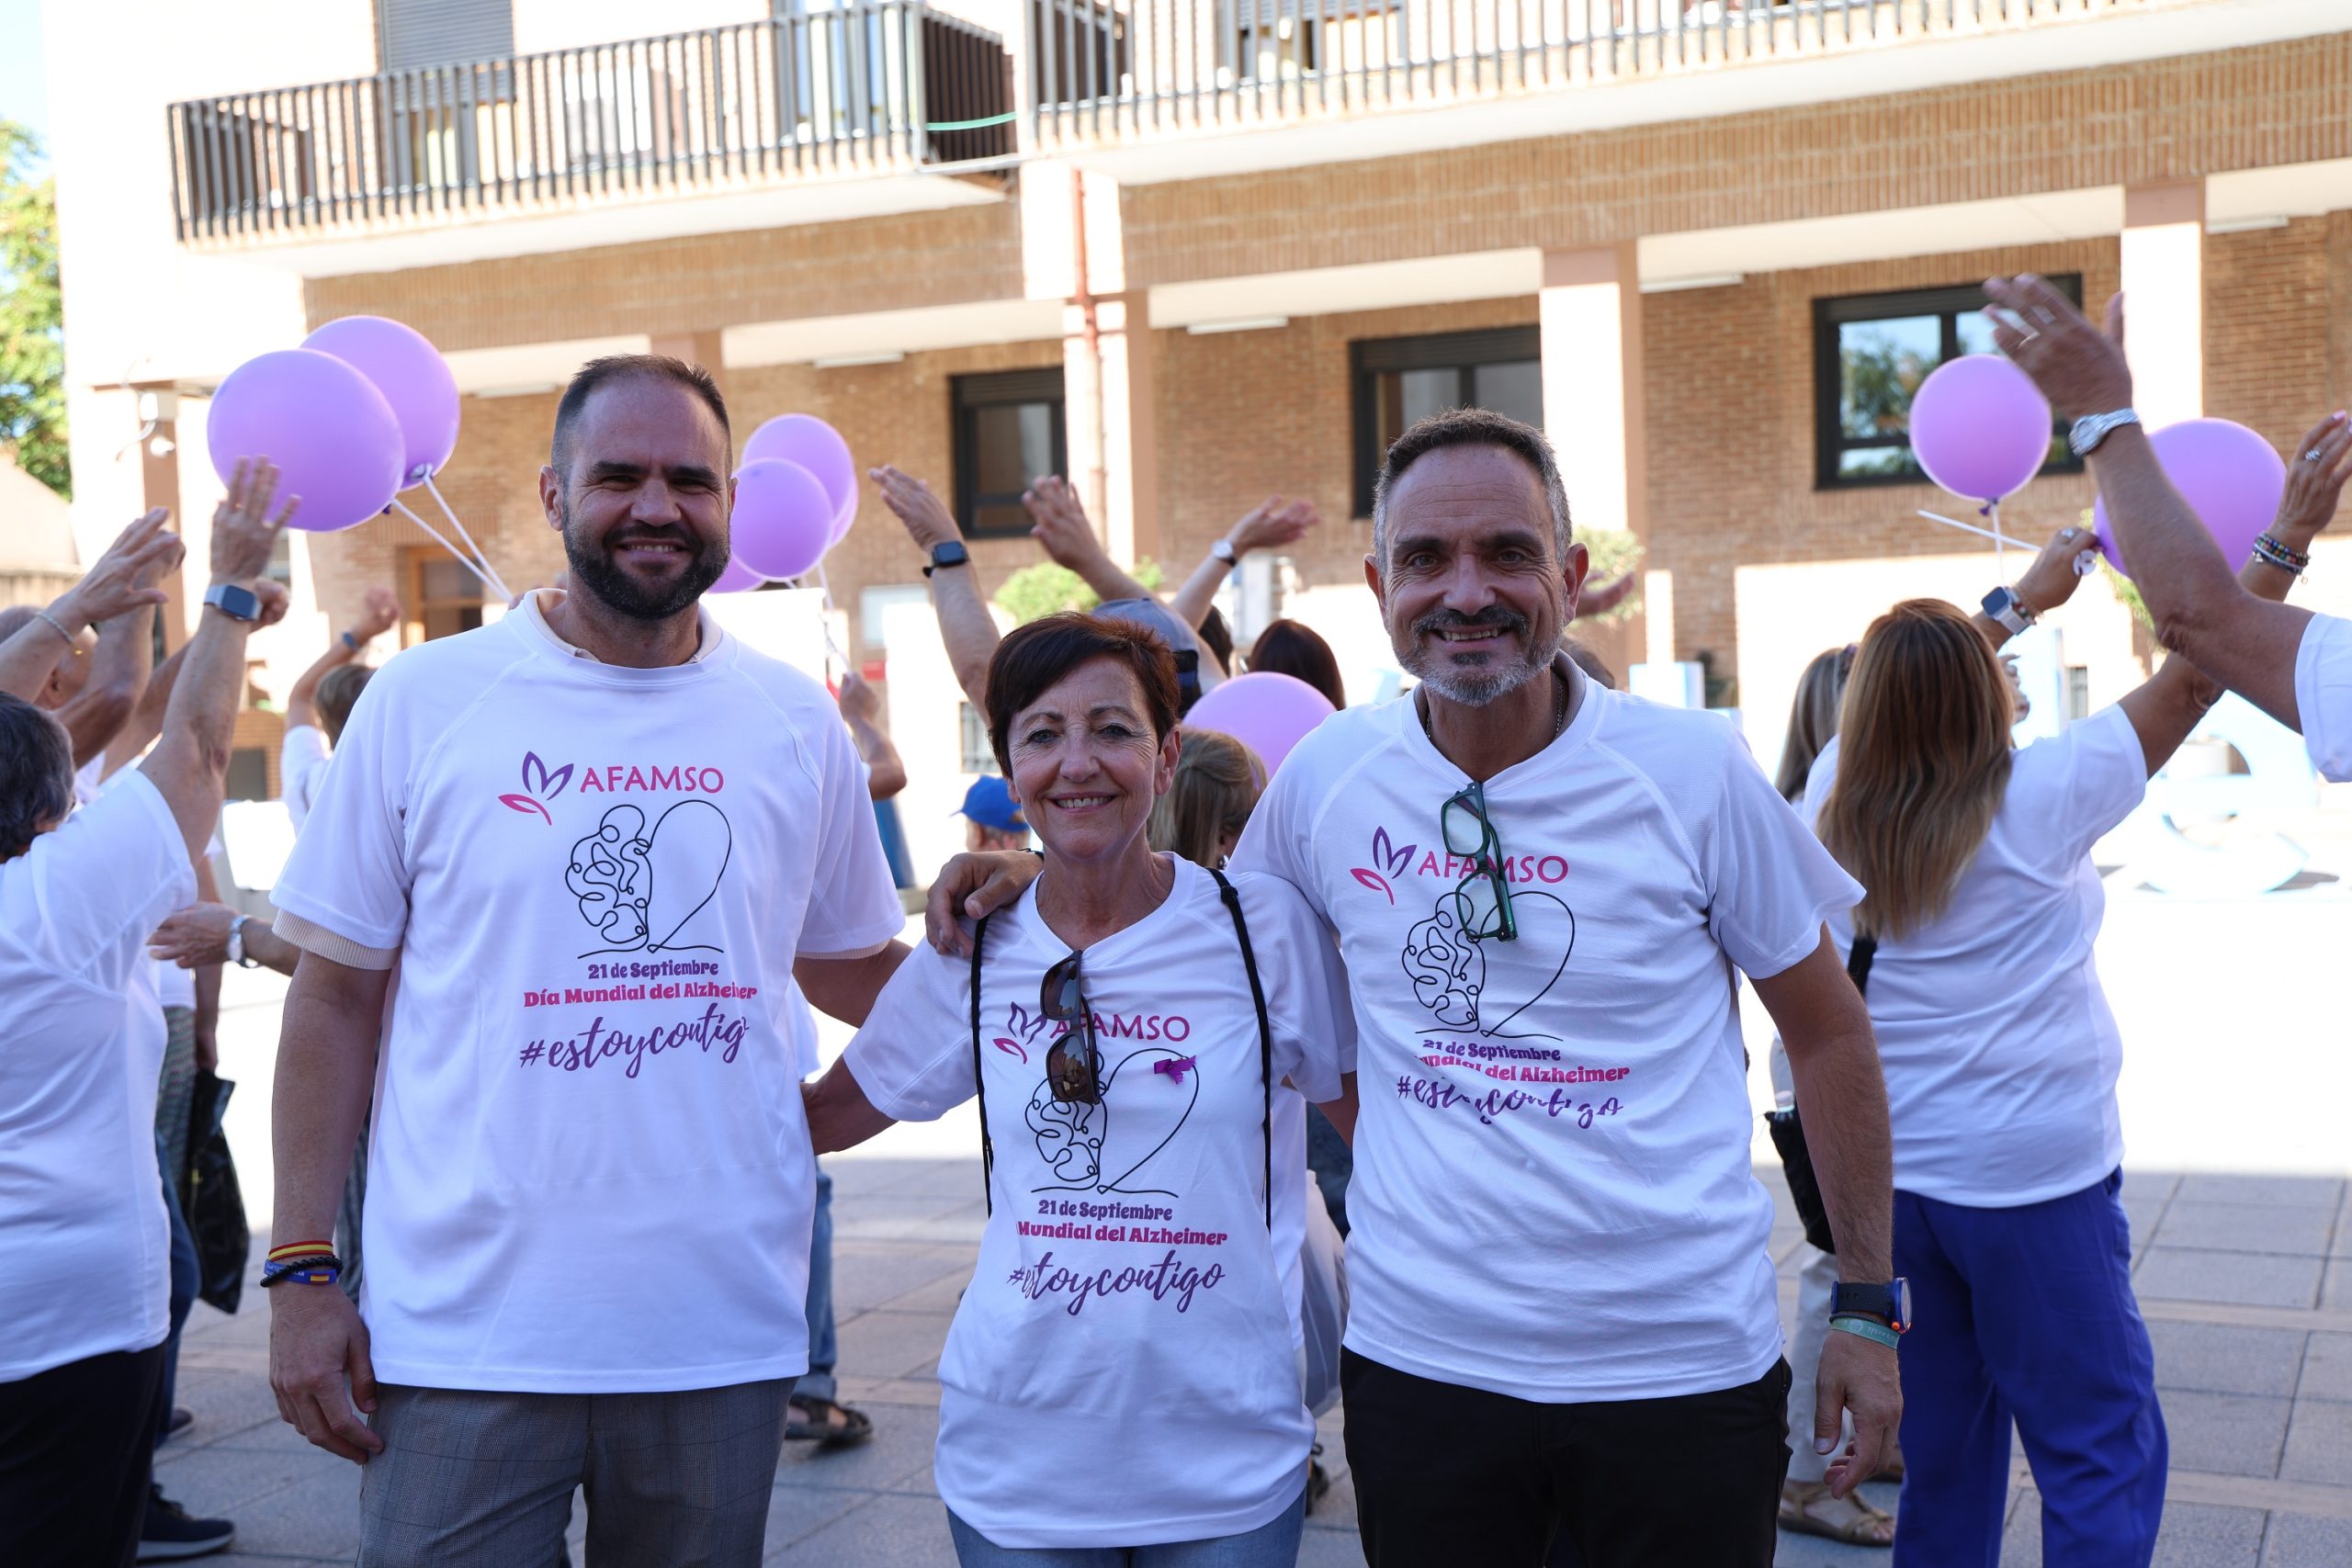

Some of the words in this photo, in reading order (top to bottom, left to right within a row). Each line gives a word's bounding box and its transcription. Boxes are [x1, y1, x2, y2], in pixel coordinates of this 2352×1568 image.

[580, 765, 724, 794] AFAMSO
[587, 964, 608, 980] 21
[610, 963, 628, 979] de
[630, 959, 719, 981] Septiembre
[524, 988, 560, 1008] Día
[564, 984, 646, 1004] Mundial
[650, 983, 681, 1000] del
[1422, 1039, 1442, 1051] 21
[1445, 1041, 1465, 1056] de
[1467, 1043, 1561, 1062] Septiembre
[1485, 1065, 1517, 1081] del
[1520, 1066, 1631, 1084] Alzheimer
[1037, 1200, 1057, 1215] 21
[1058, 1201, 1078, 1217] de
[1079, 1201, 1173, 1222] Septiembre
[1017, 1221, 1092, 1240] Mundial
[1094, 1224, 1126, 1241] del
[1128, 1226, 1228, 1246] Alzheimer
